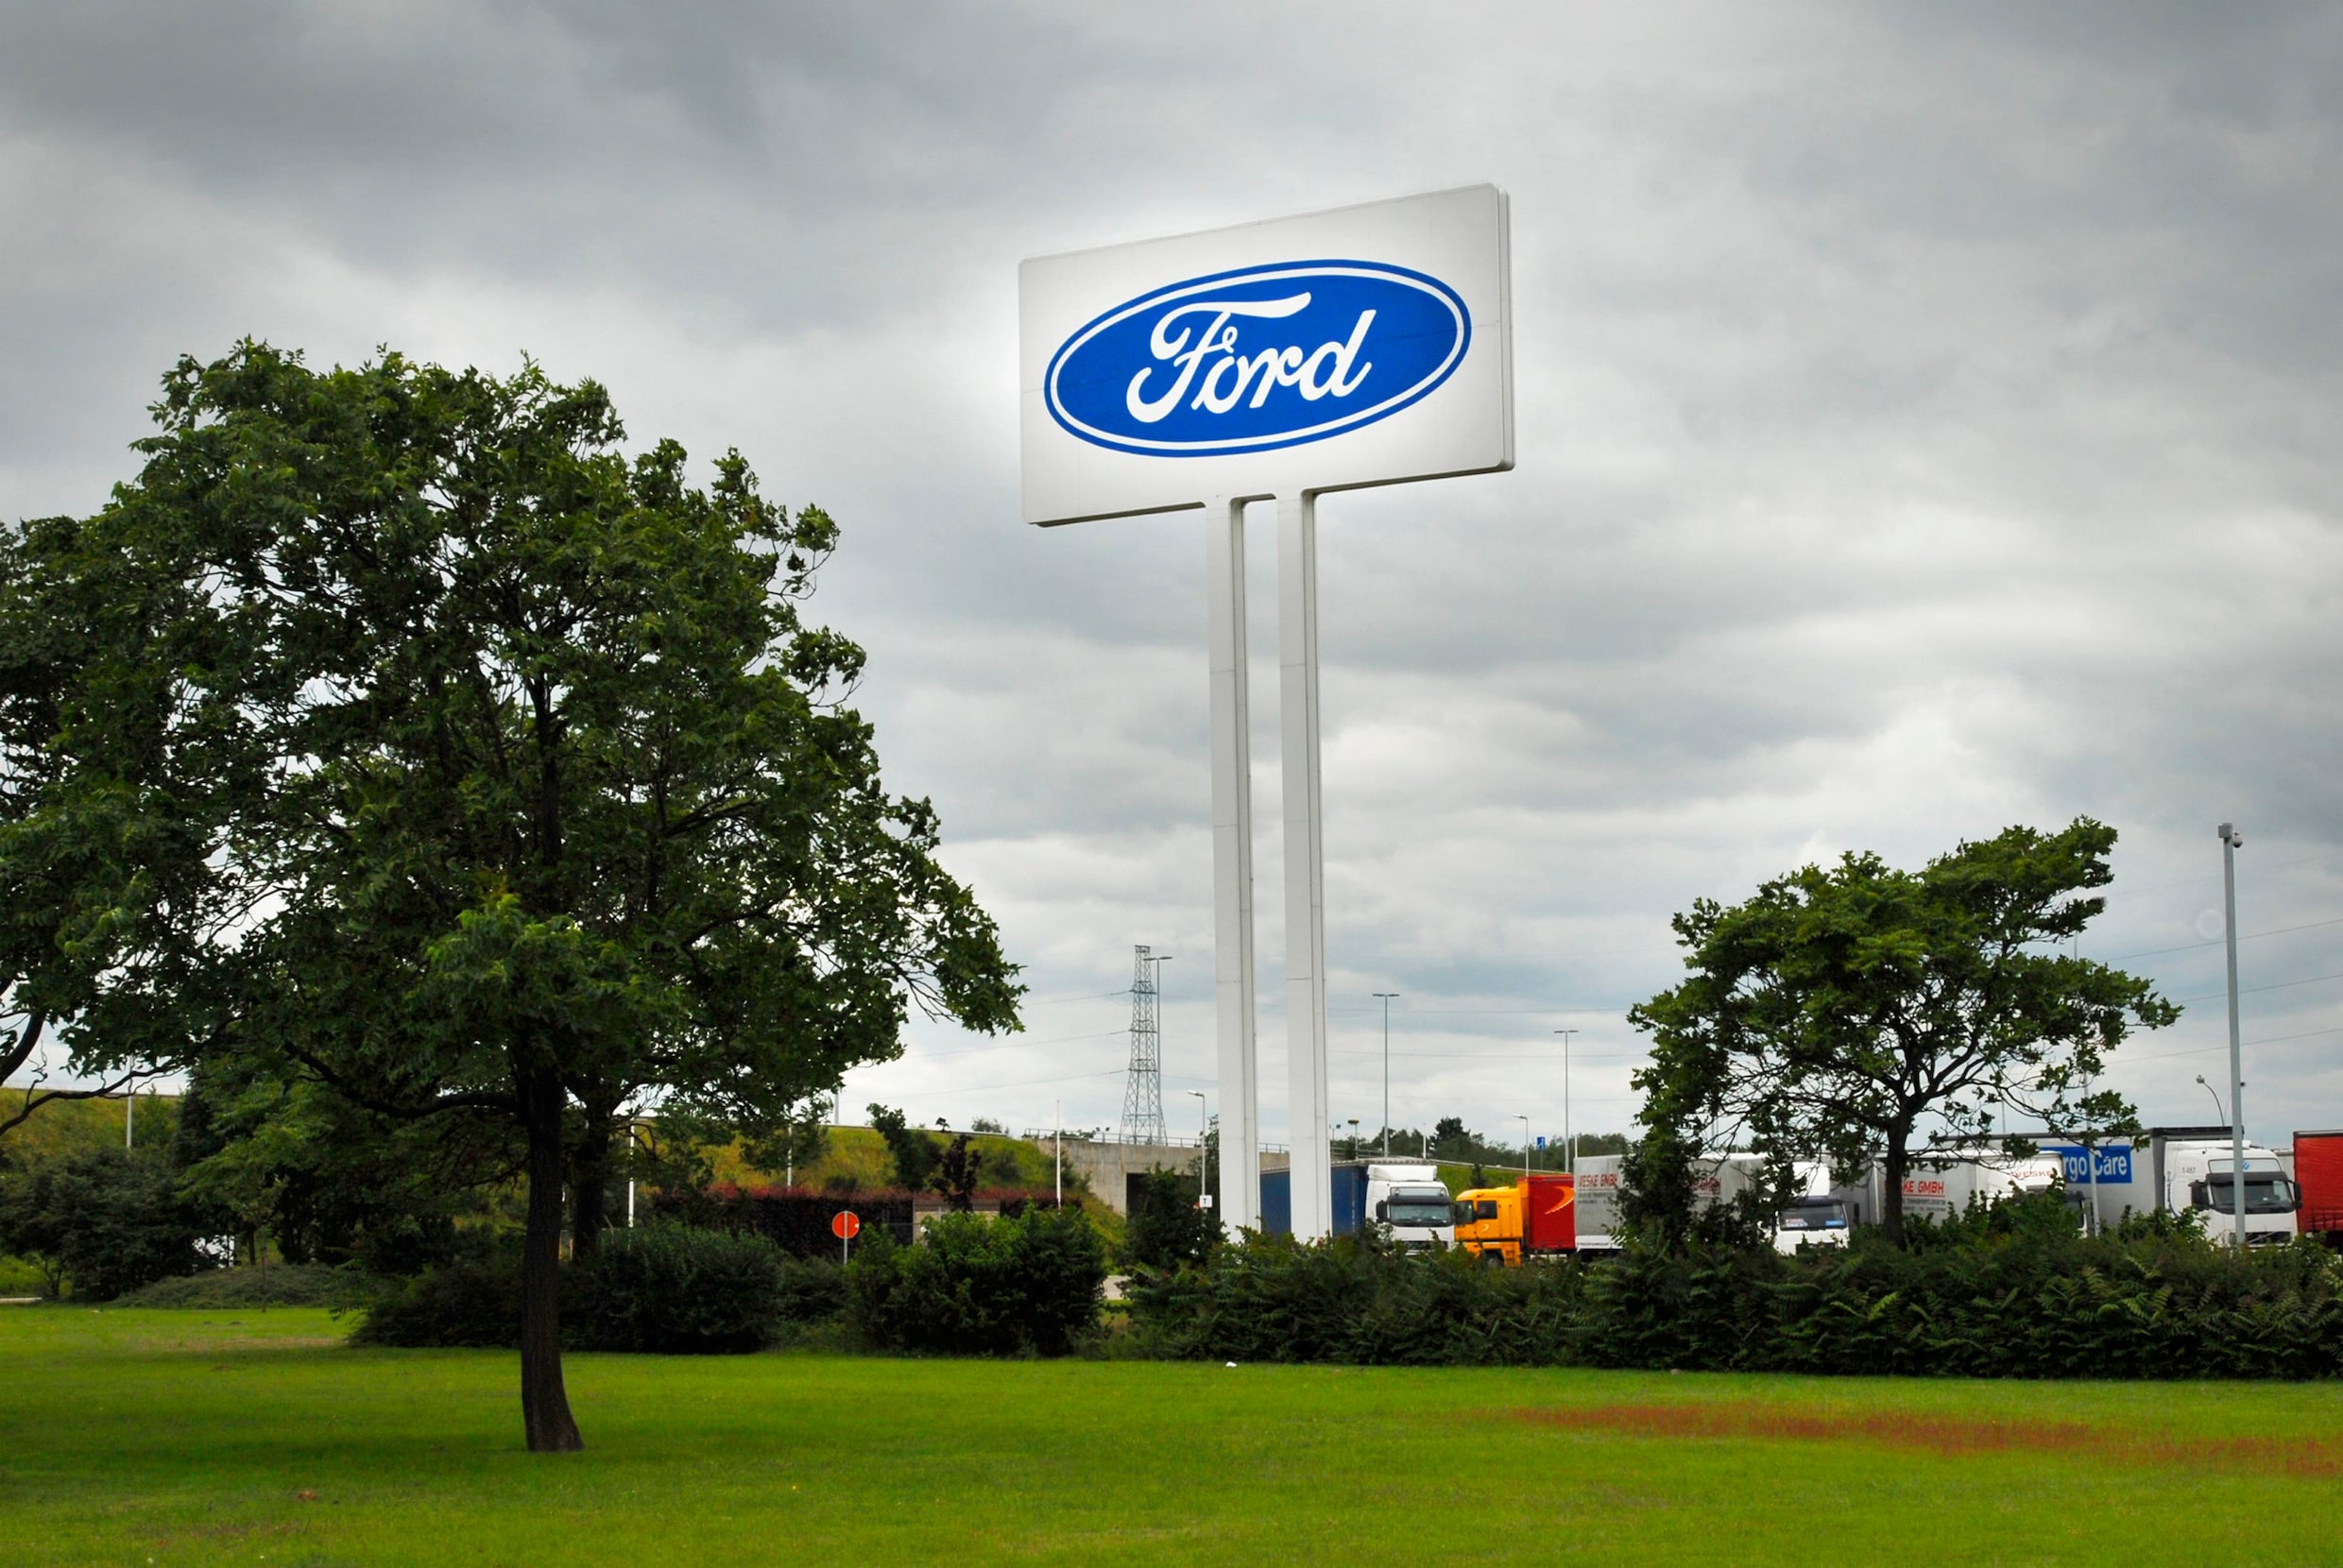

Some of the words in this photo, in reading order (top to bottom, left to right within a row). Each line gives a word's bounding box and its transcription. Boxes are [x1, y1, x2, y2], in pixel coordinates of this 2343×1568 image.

[1125, 291, 1377, 423] Ford
[2062, 1156, 2088, 1182] rgo
[2094, 1150, 2128, 1176] Care
[1918, 1181, 1944, 1194] GMBH
